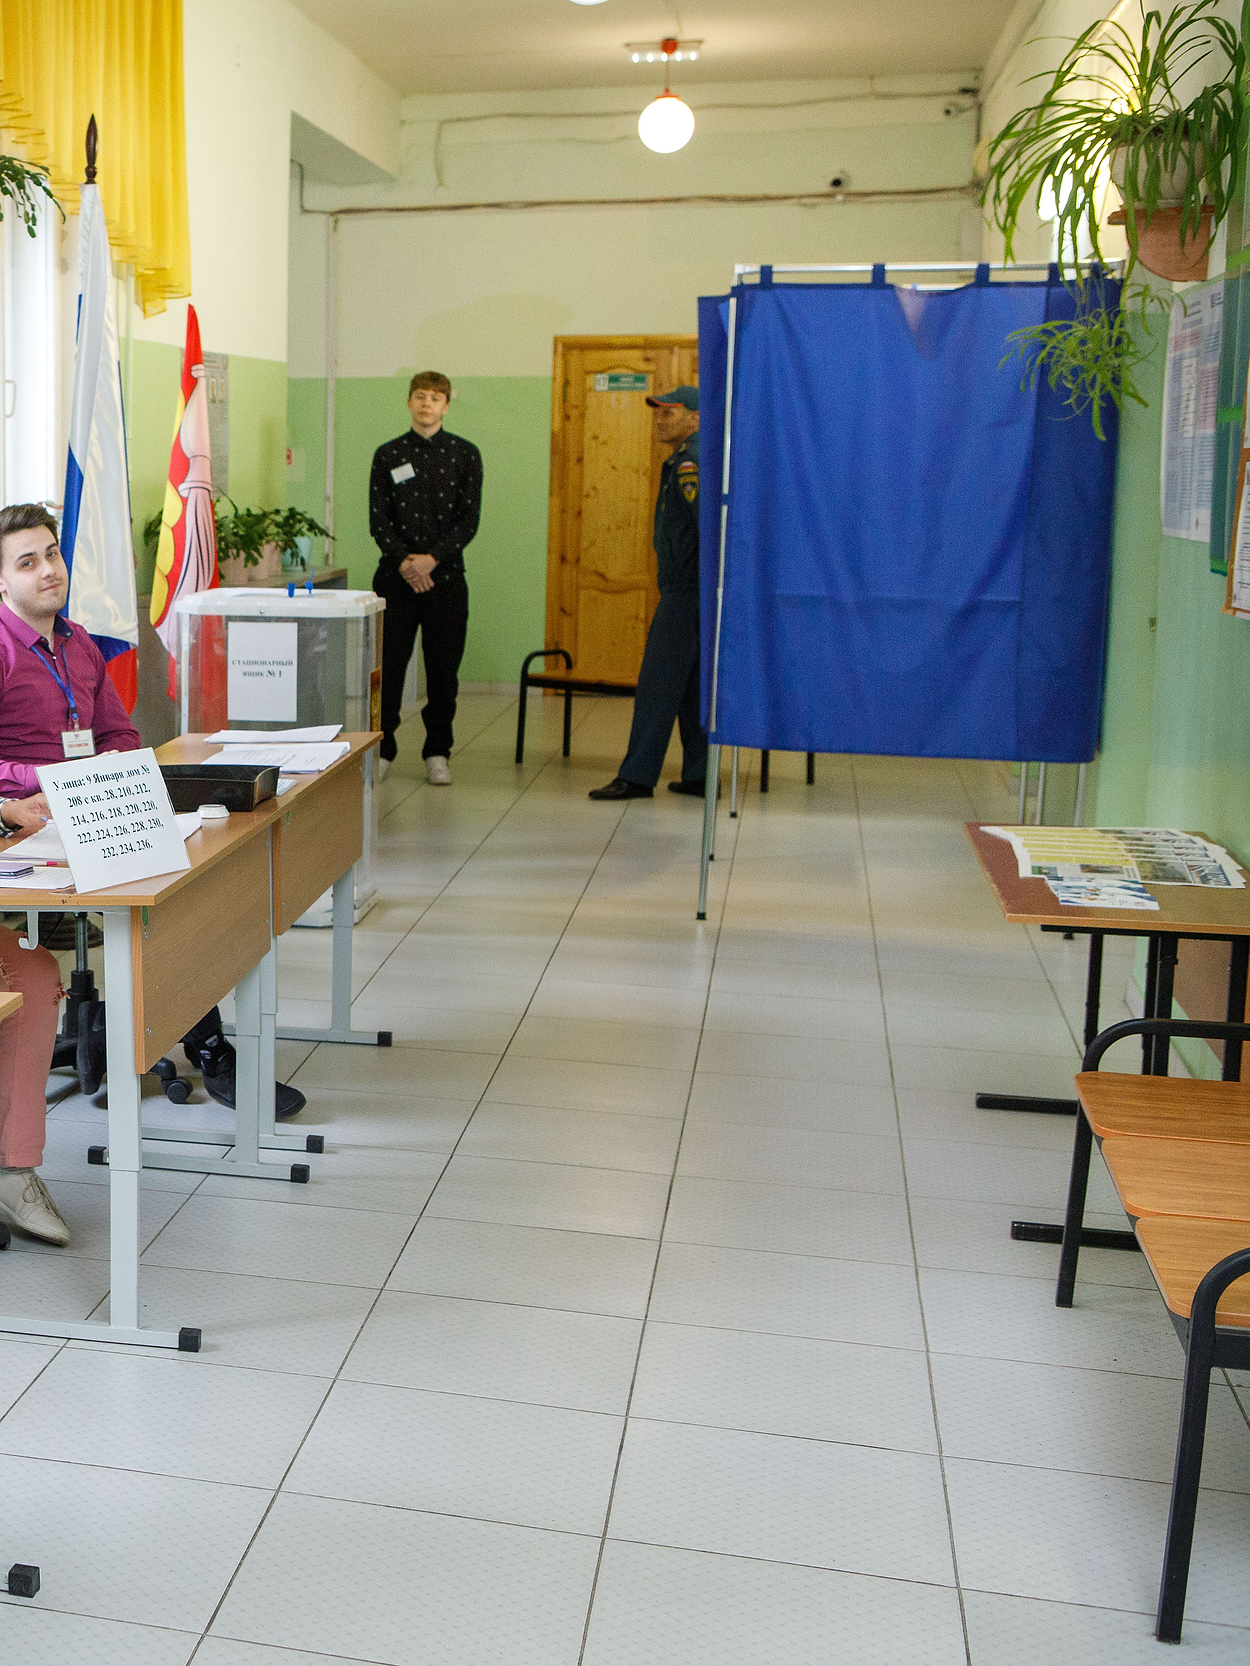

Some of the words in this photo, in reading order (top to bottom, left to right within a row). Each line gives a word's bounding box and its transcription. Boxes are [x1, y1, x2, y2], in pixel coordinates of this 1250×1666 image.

[52, 777, 86, 792] Улица:
[86, 774, 92, 785] 9
[92, 770, 125, 784] Января
[126, 768, 140, 779] дом
[141, 764, 150, 775] №
[67, 795, 83, 808] 208
[84, 796, 90, 804] с
[90, 793, 104, 804] кв.
[104, 789, 117, 800] 28,
[117, 786, 134, 798] 210,
[90, 811, 107, 823] 216,
[108, 807, 125, 820] 218,
[125, 804, 142, 816] 220,
[77, 832, 95, 844] 222,
[95, 828, 113, 841] 224,
[113, 824, 131, 838] 226,
[131, 821, 148, 834] 228,
[101, 846, 119, 859] 232,
[119, 842, 136, 855] 234,
